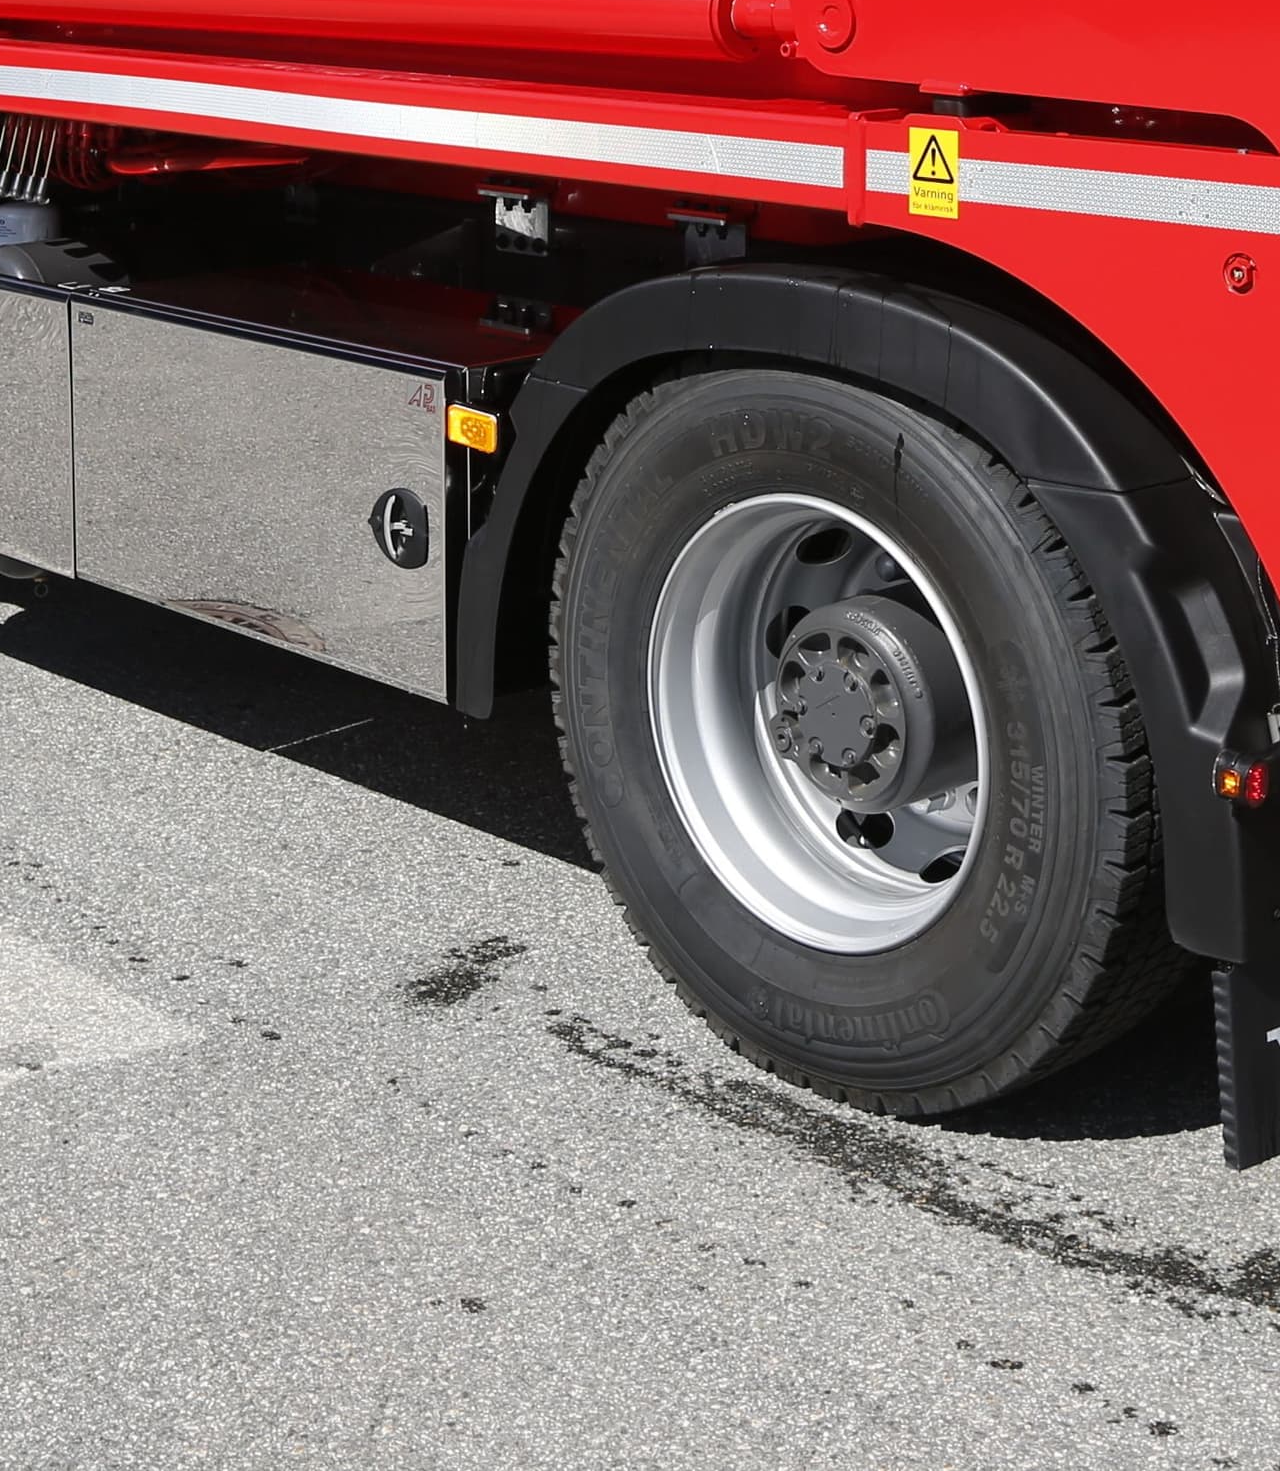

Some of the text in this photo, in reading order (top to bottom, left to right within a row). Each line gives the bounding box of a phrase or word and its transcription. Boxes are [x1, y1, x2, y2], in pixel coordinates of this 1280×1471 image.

[913, 186, 954, 204] Varning
[979, 720, 1032, 944] 315/70 R 22.5
[1027, 765, 1046, 854] WINTER
